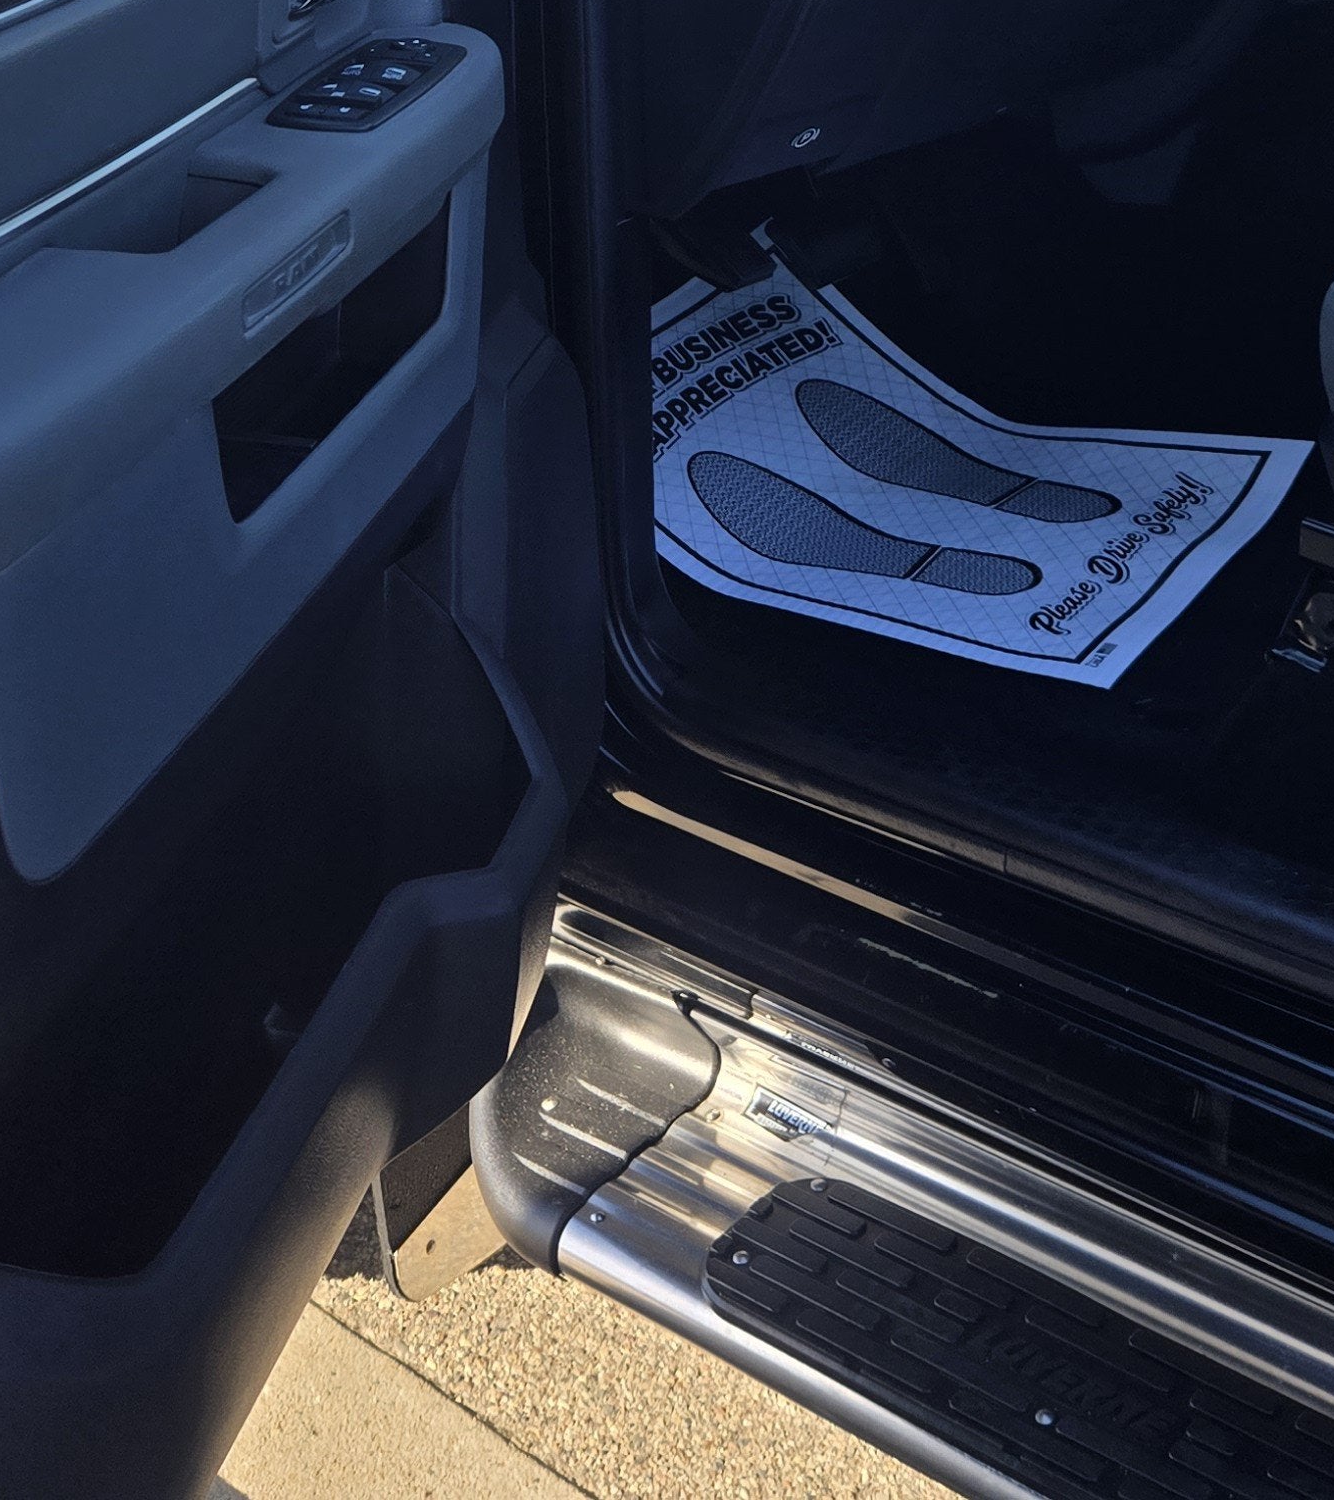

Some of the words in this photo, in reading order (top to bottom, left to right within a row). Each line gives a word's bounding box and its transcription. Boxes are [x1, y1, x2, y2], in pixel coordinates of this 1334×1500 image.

[652, 294, 800, 388] BUSINESS
[1028, 580, 1097, 636] Please
[1087, 531, 1147, 586] Drive
